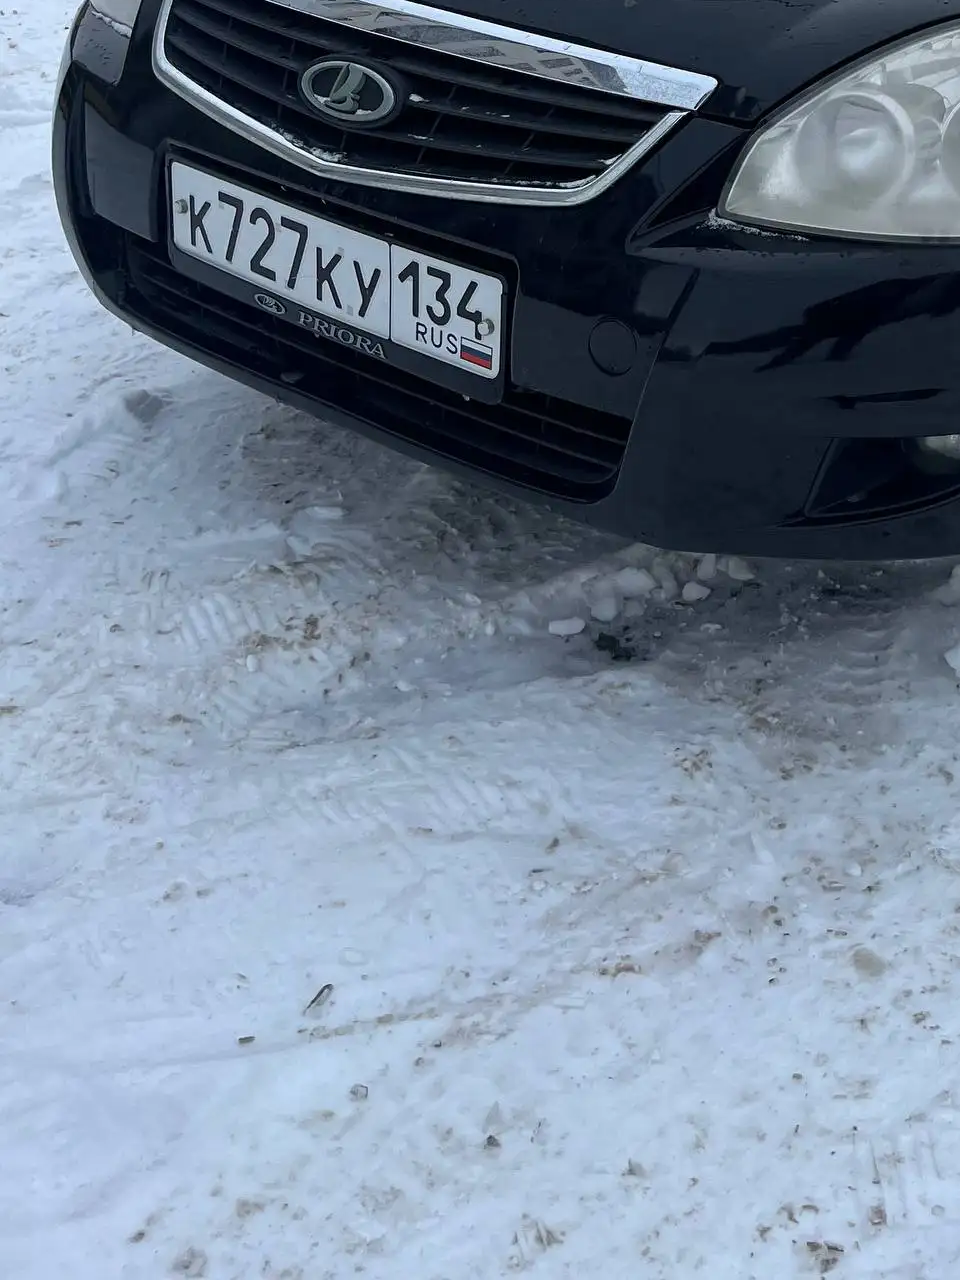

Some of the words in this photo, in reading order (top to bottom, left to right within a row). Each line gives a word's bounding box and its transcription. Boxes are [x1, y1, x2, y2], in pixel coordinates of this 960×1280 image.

[398, 260, 484, 341] 134
[298, 310, 387, 360] PRIORA
[416, 322, 459, 355] RUS
